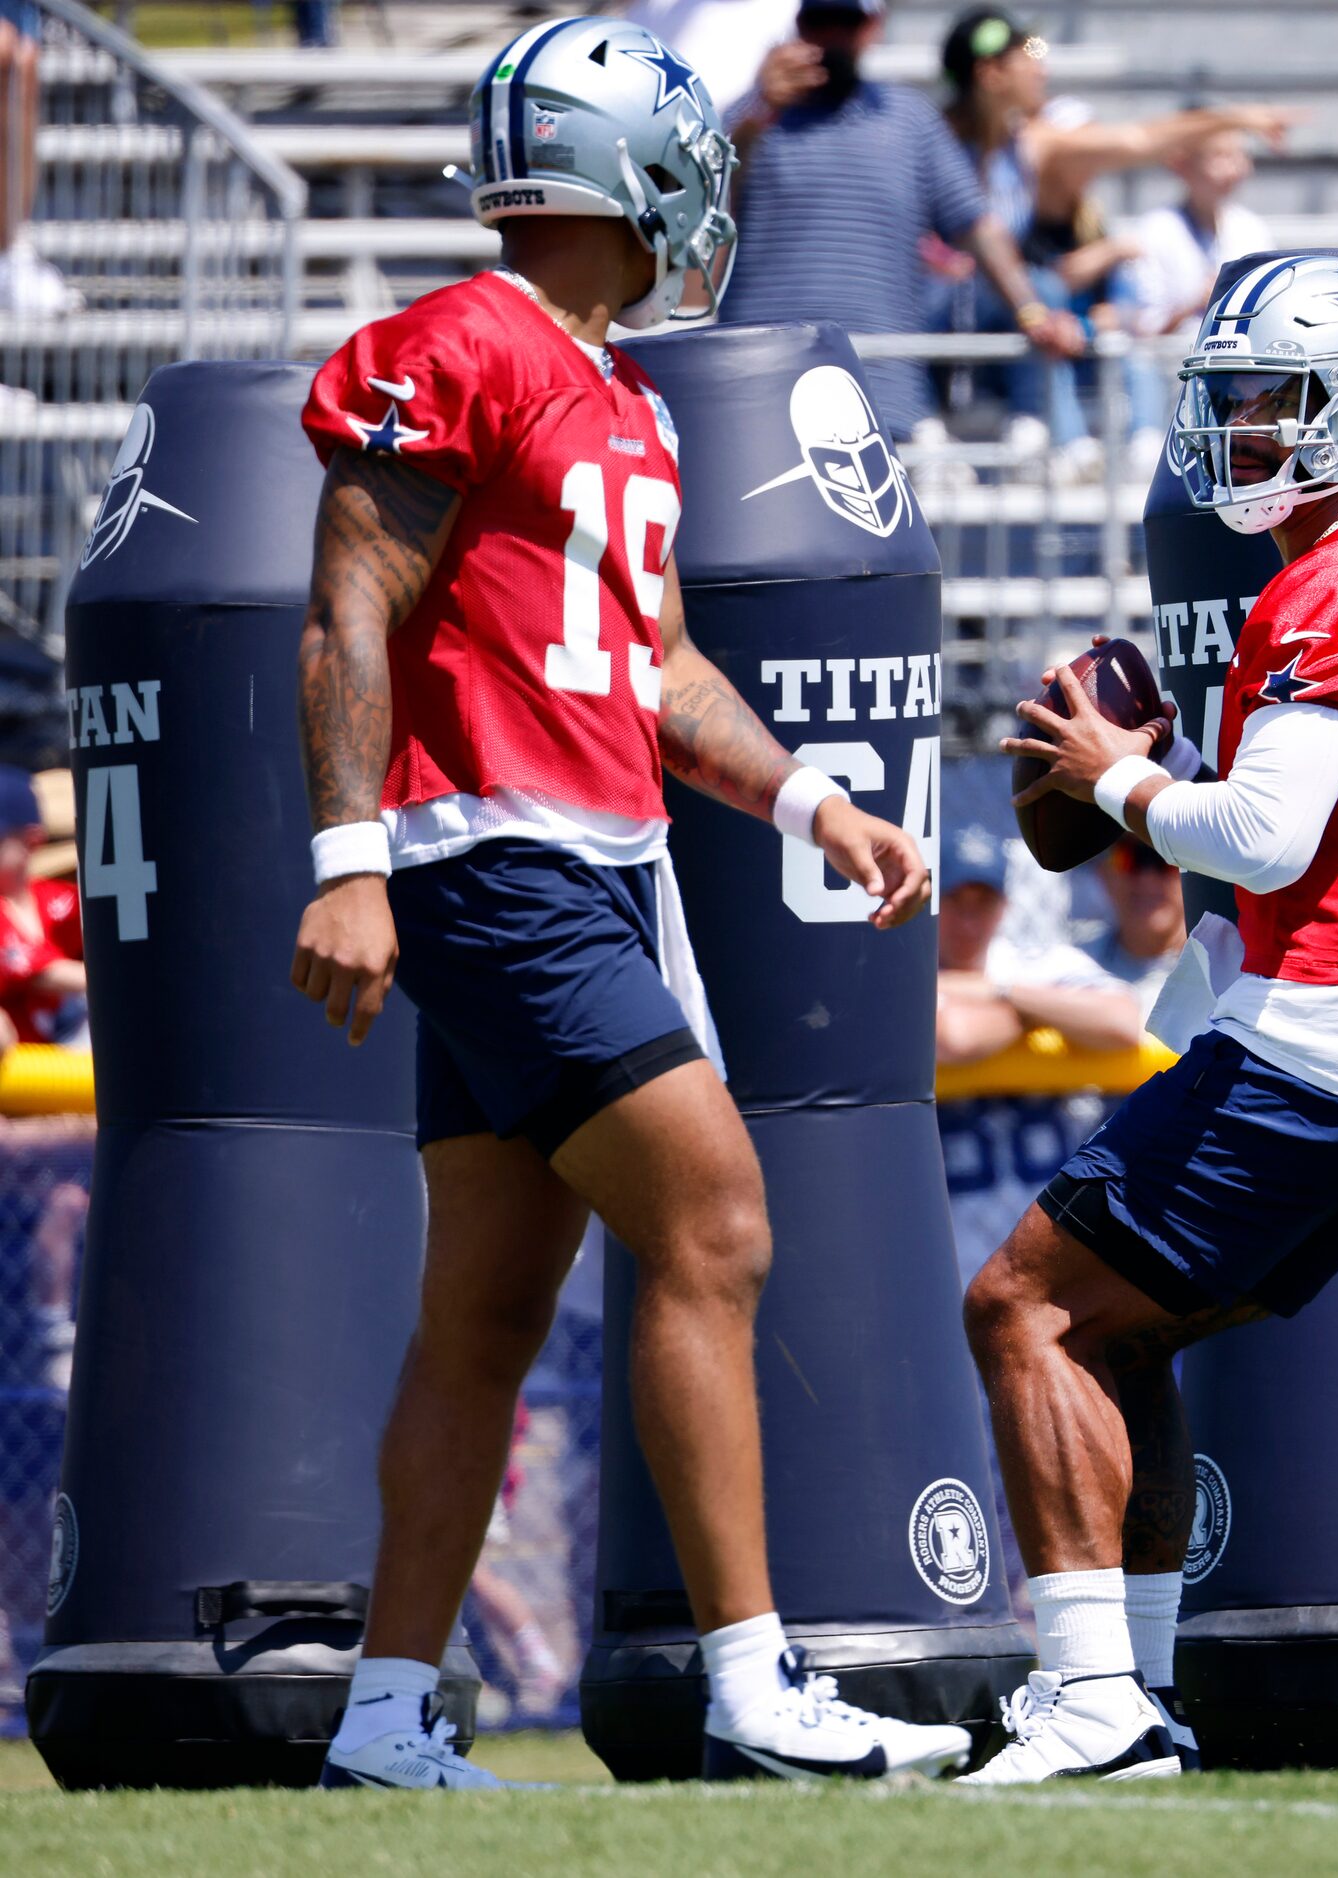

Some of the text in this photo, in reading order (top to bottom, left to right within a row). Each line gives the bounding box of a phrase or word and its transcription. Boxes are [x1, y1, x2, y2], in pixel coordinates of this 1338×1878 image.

[479, 189, 546, 212] COWBOYS
[1204, 340, 1238, 351] COWBOYS
[545, 461, 682, 712] 19
[84, 764, 158, 942] 4
[782, 735, 941, 924] 64
[917, 1488, 986, 1566] ROGERS ATHLETIC COMPANY
[1207, 1474, 1224, 1537] COMPANY
[933, 1509, 977, 1574] R
[938, 1570, 983, 1594] ROGERS
